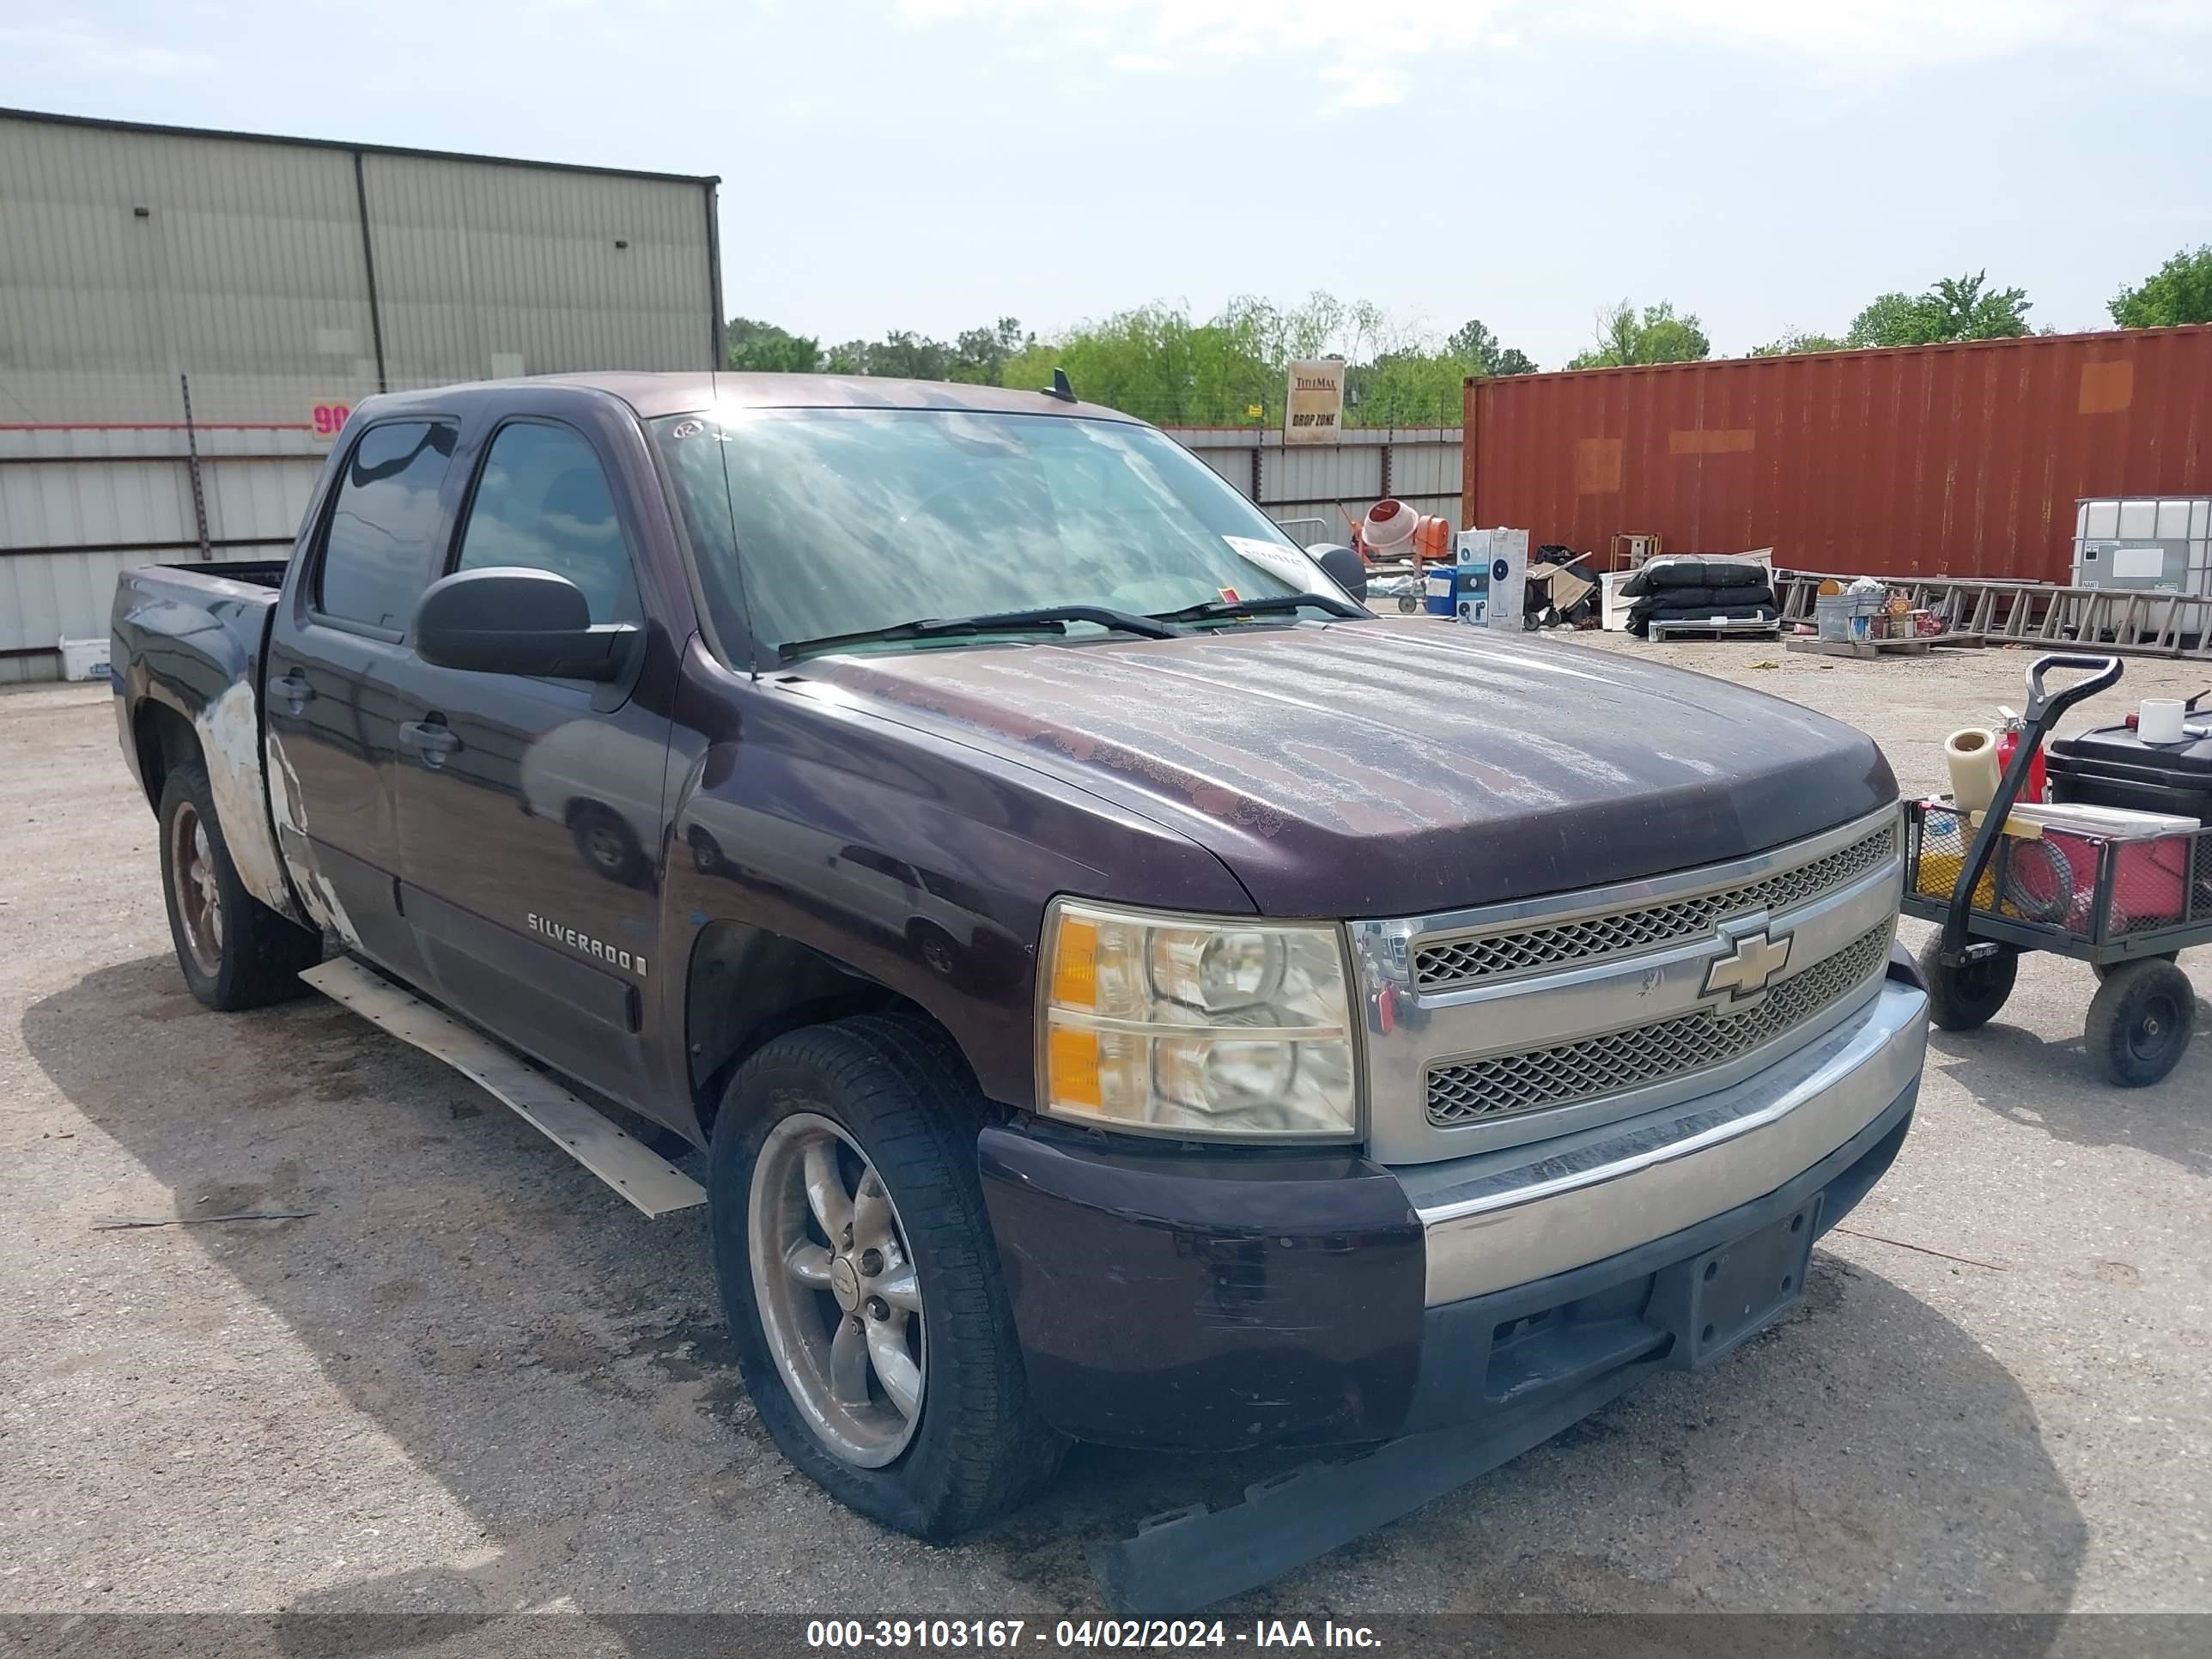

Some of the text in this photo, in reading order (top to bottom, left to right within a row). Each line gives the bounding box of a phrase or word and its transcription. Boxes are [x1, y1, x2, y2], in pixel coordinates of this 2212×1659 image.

[1292, 413, 1334, 427] DROP ZONE
[528, 913, 632, 970] SILVERADO
